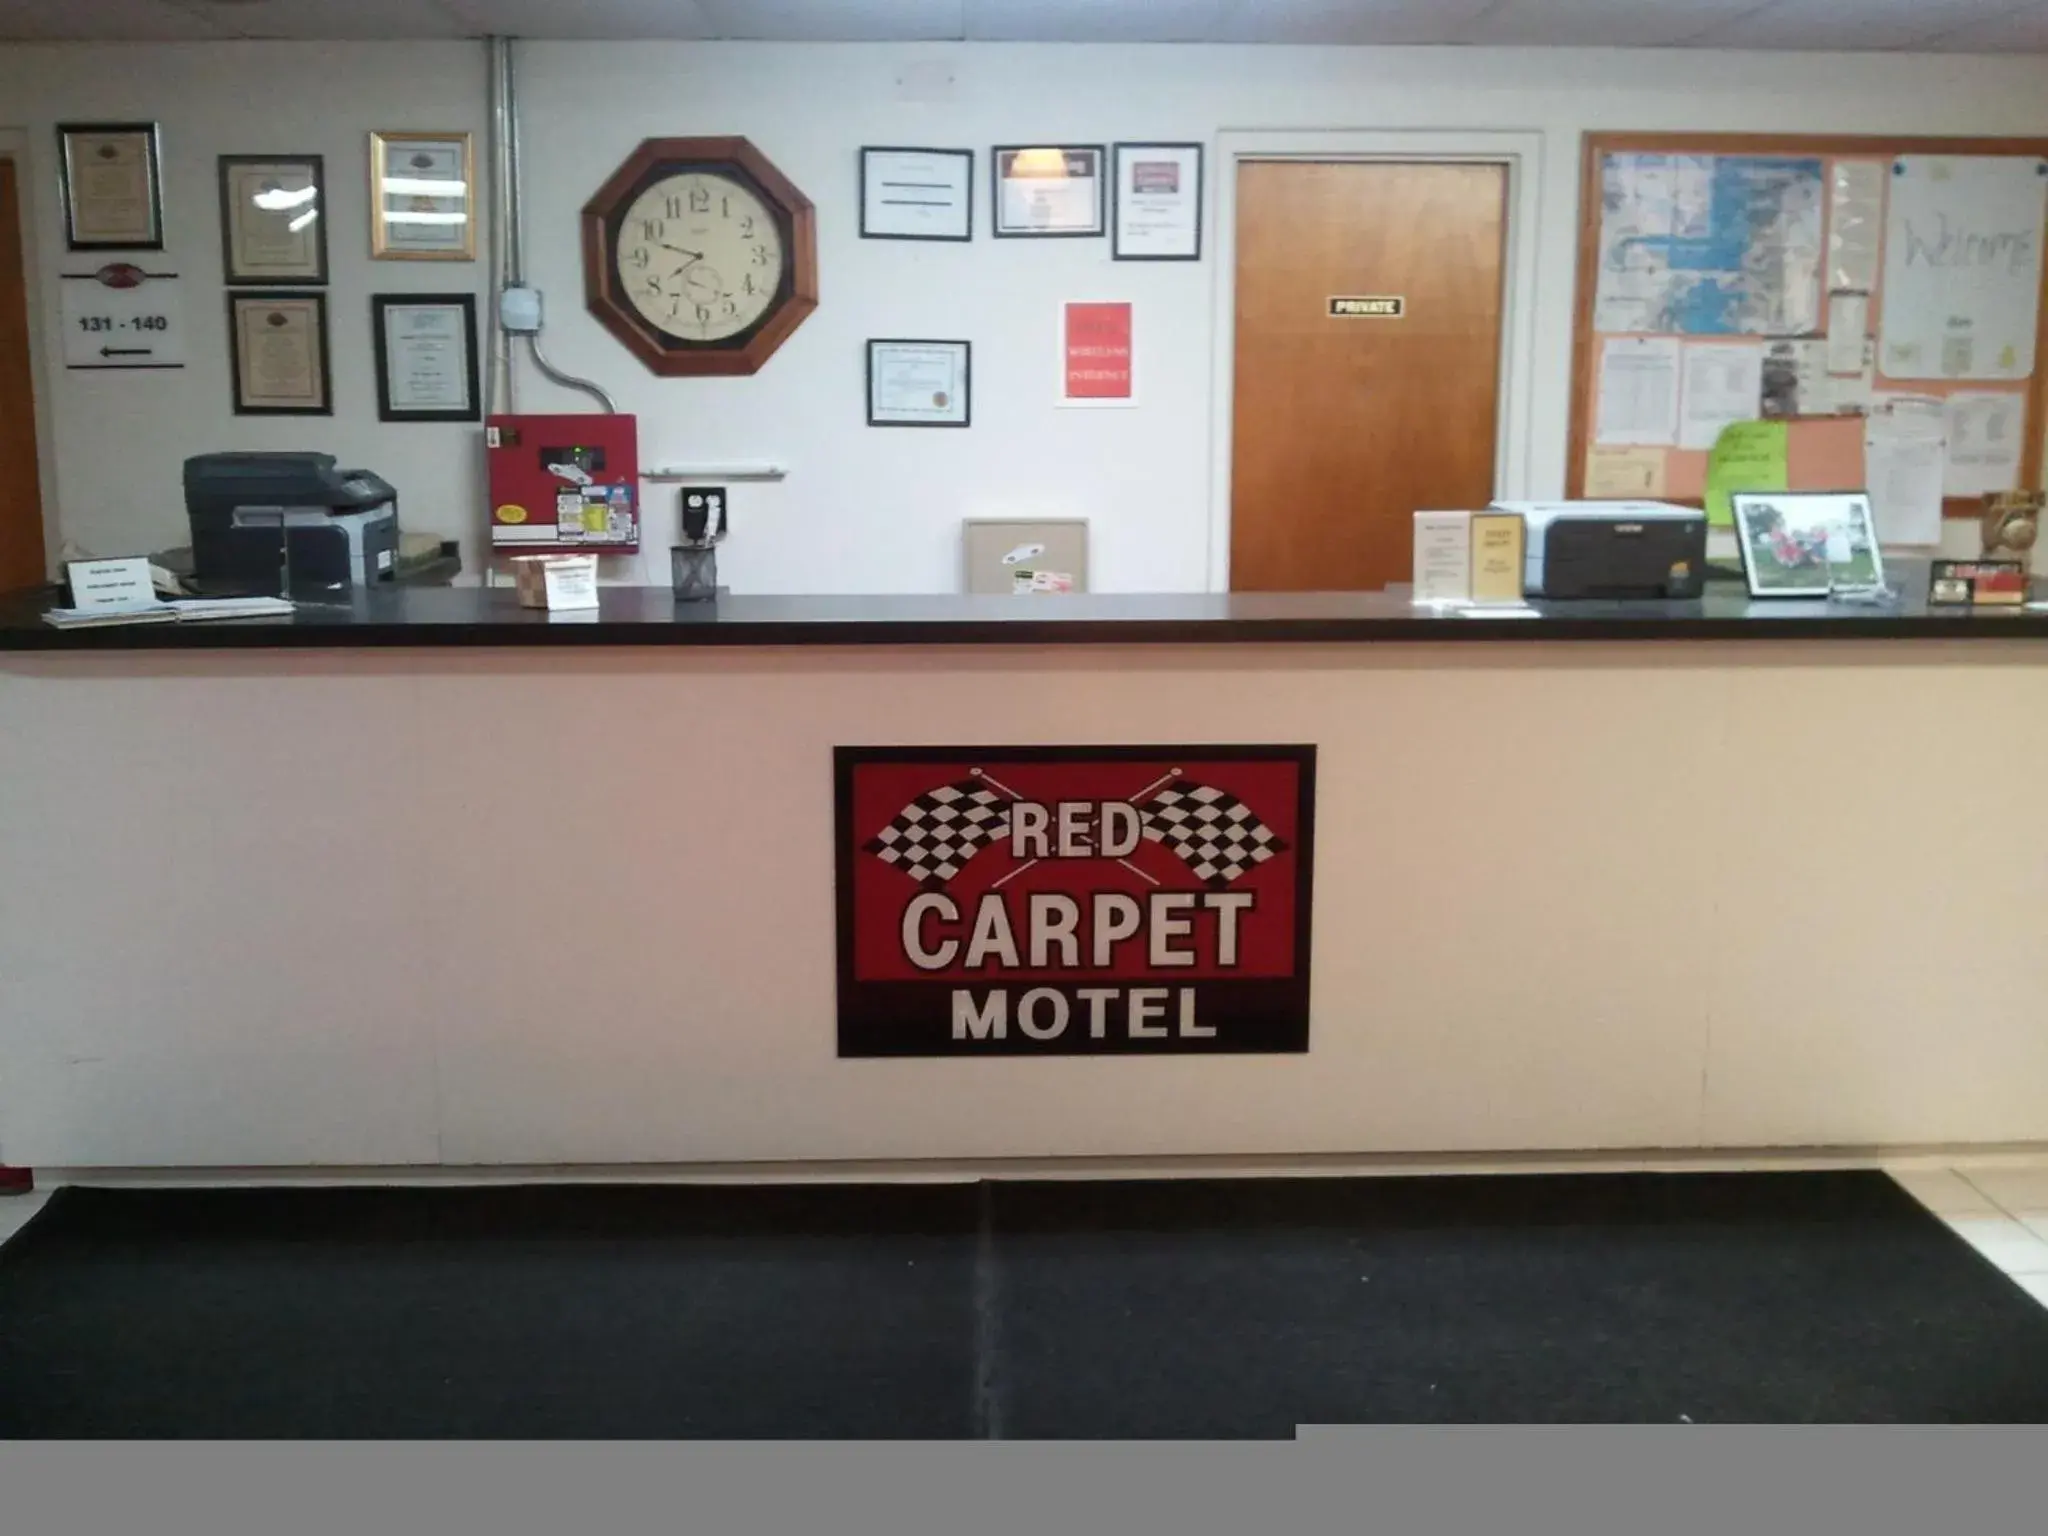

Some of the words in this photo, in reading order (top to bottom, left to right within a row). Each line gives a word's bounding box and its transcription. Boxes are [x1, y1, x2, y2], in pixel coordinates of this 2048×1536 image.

[665, 196, 681, 219] 11
[688, 188, 711, 213] 12
[721, 197, 730, 218] 1
[643, 218, 664, 241] 10
[740, 216, 754, 239] 2
[634, 248, 649, 268] 9
[752, 246, 767, 267] 3
[647, 276, 662, 297] 8
[741, 274, 755, 296] 4
[669, 293, 681, 316] 7
[696, 304, 710, 321] 6
[723, 293, 737, 315] 5
[1334, 299, 1396, 314] PRIVATE
[79, 316, 112, 332] 131
[131, 316, 168, 331] 140
[1012, 801, 1143, 859] RED
[901, 892, 1254, 970] CARPET
[951, 987, 1218, 1040] MOTEL
